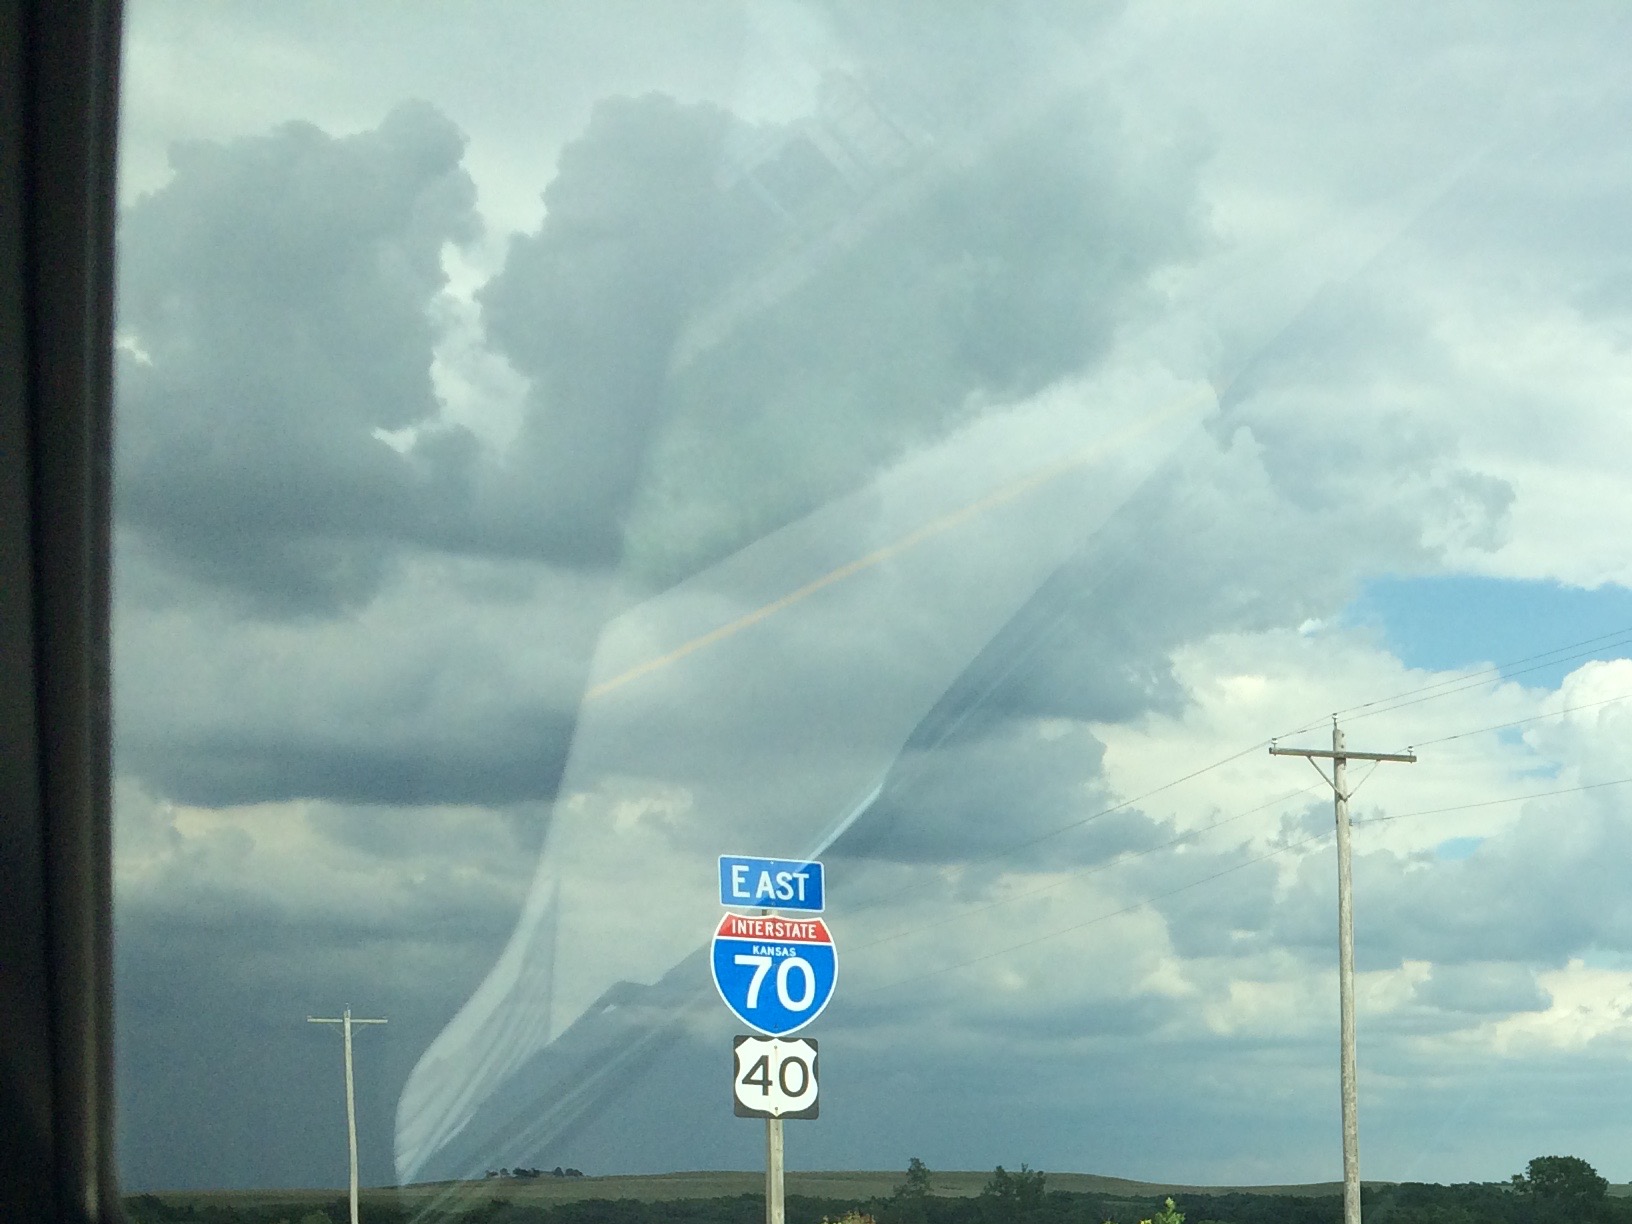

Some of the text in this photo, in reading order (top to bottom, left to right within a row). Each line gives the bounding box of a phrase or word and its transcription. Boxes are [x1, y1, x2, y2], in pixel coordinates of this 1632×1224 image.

[732, 865, 809, 901] EAST
[732, 919, 816, 939] INTERSTATE
[752, 945, 796, 957] KANSAS
[734, 954, 816, 1012] 70
[742, 1055, 809, 1097] 40
